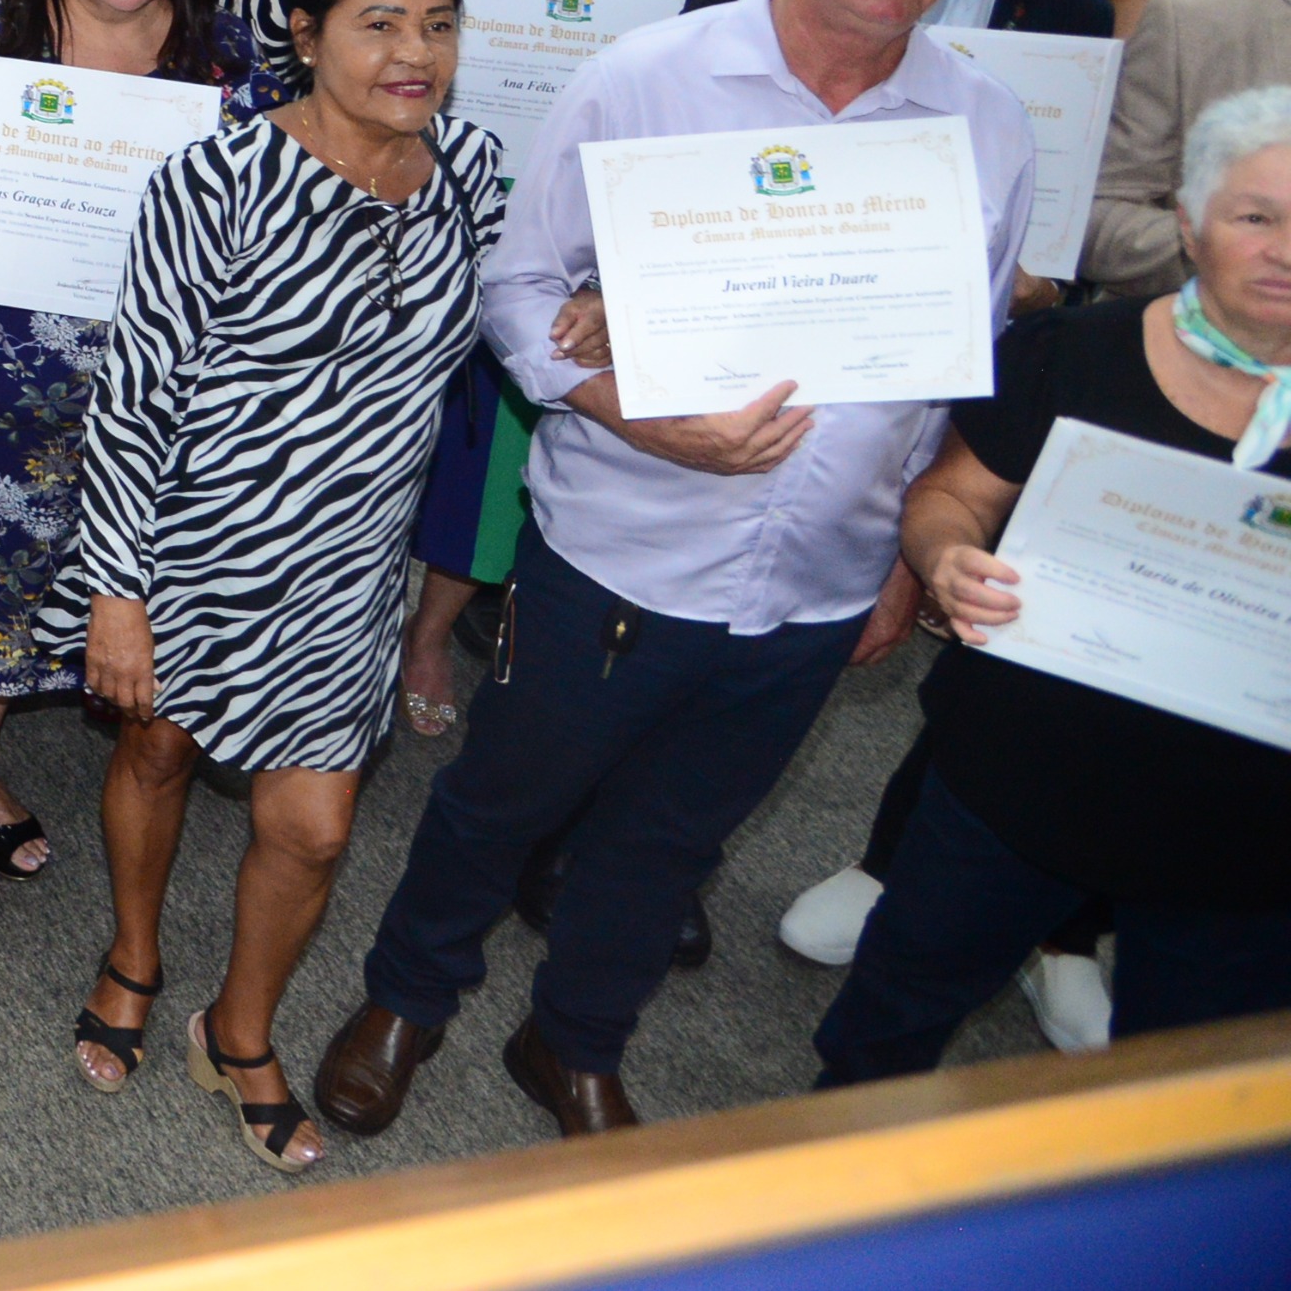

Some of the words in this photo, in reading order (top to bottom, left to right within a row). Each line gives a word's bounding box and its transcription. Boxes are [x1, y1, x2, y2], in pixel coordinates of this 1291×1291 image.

[498, 78, 523, 89] Ana
[526, 80, 557, 93] Félix
[12, 190, 57, 207] Graças
[59, 198, 75, 210] de
[77, 200, 116, 217] Souza
[721, 276, 776, 292] Juvenil
[782, 274, 823, 288] Vieira
[829, 273, 878, 285] Duarte
